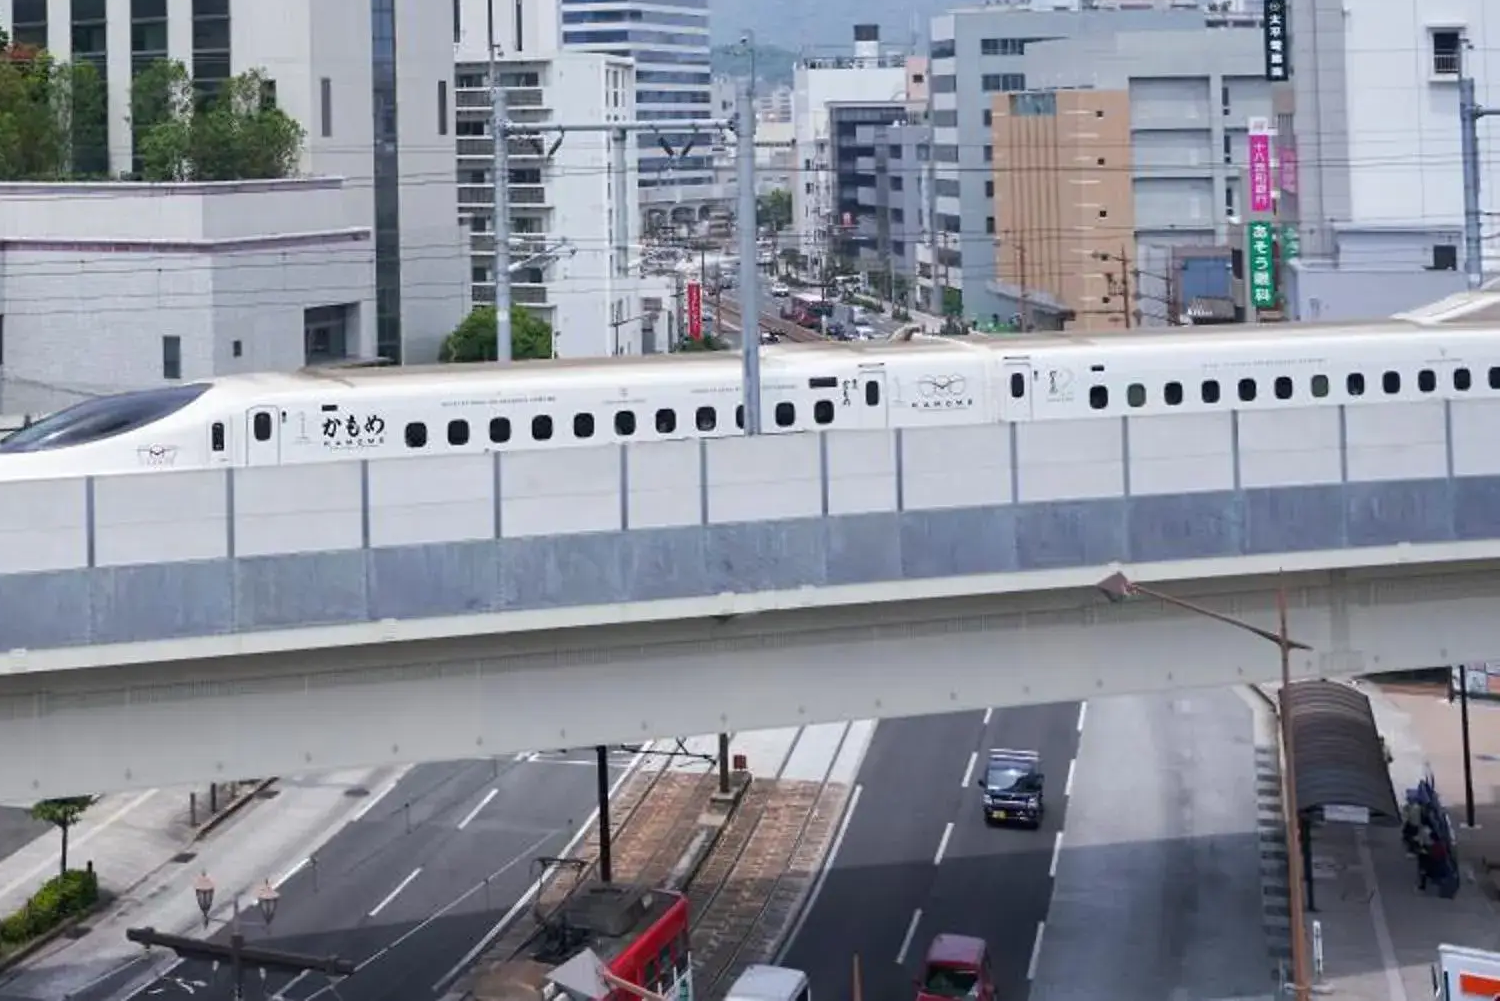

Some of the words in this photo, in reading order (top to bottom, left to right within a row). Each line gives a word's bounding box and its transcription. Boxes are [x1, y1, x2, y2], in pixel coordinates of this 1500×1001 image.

[1252, 225, 1271, 301] あそう眼科
[322, 414, 385, 438] かもめ
